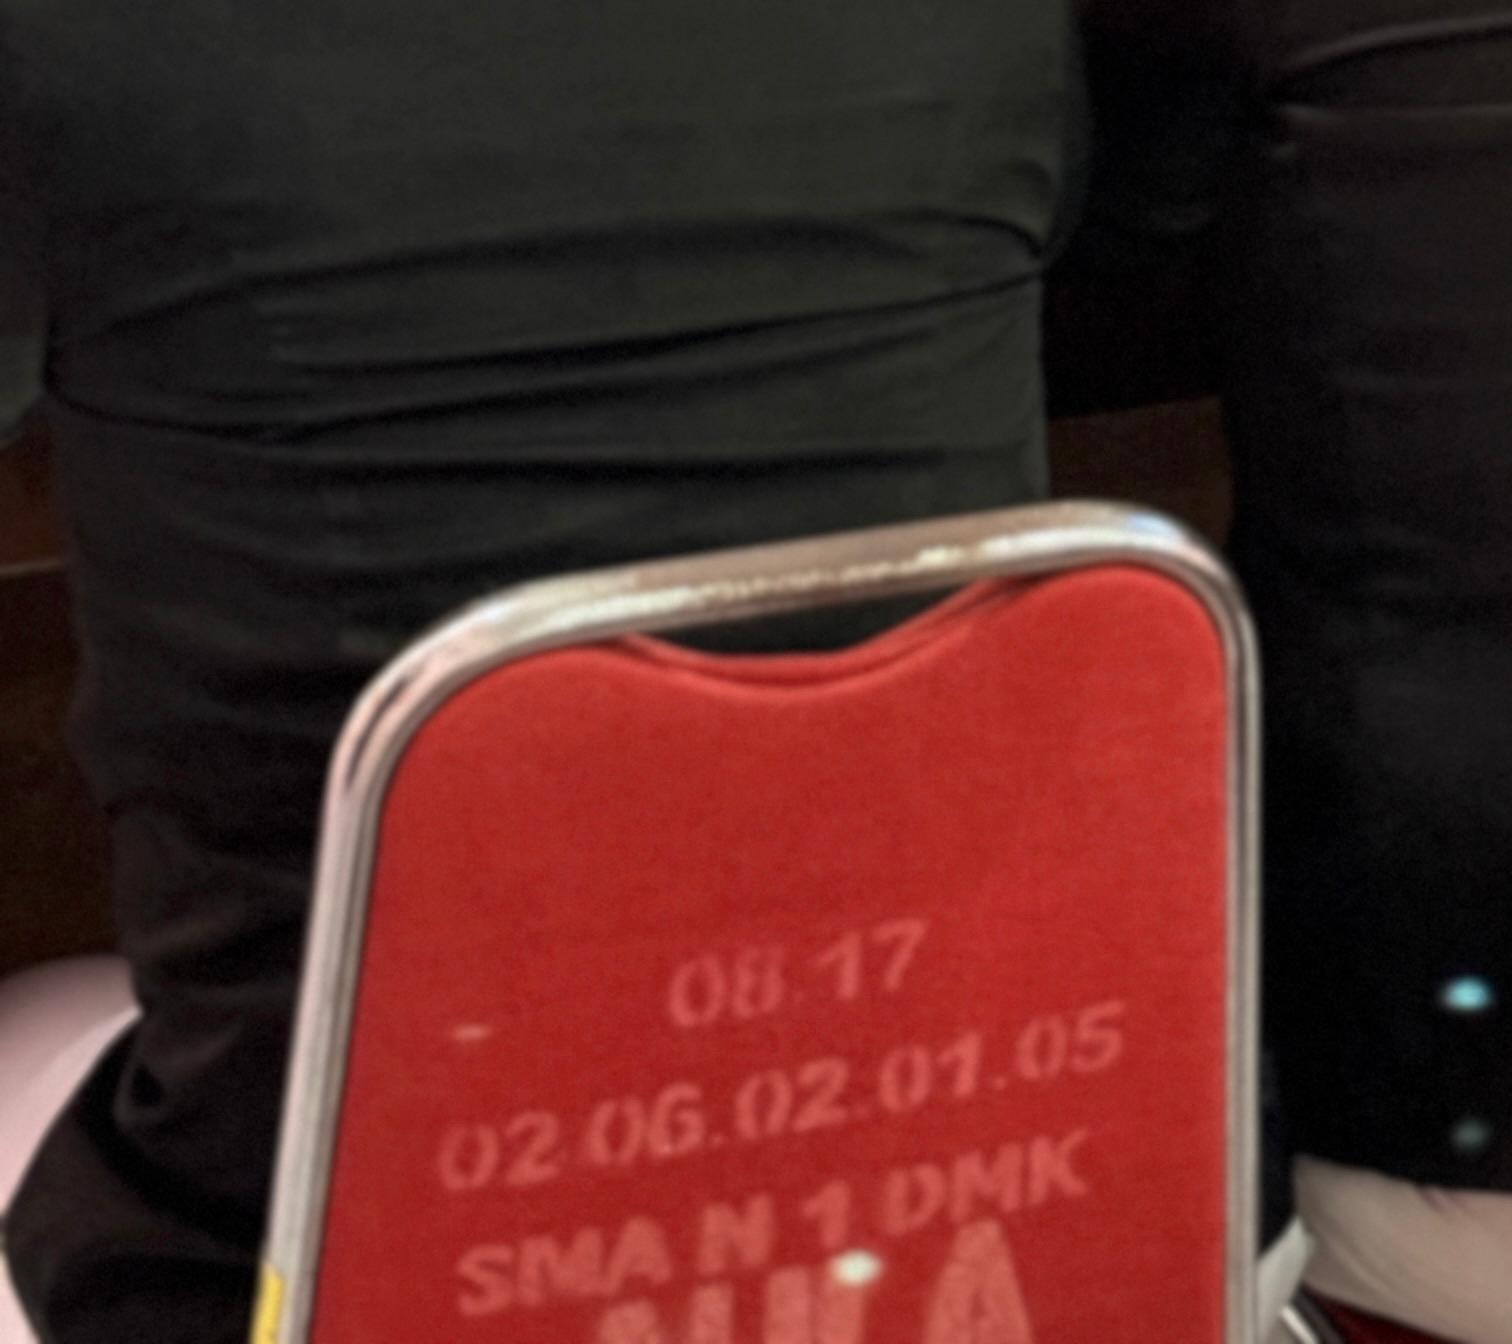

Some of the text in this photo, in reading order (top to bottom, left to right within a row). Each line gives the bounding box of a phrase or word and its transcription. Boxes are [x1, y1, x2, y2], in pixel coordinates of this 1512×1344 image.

[456, 1216, 672, 1317] SMA
[697, 1192, 776, 1276] N
[801, 1178, 853, 1249] 1
[882, 1127, 1091, 1238] DMK
